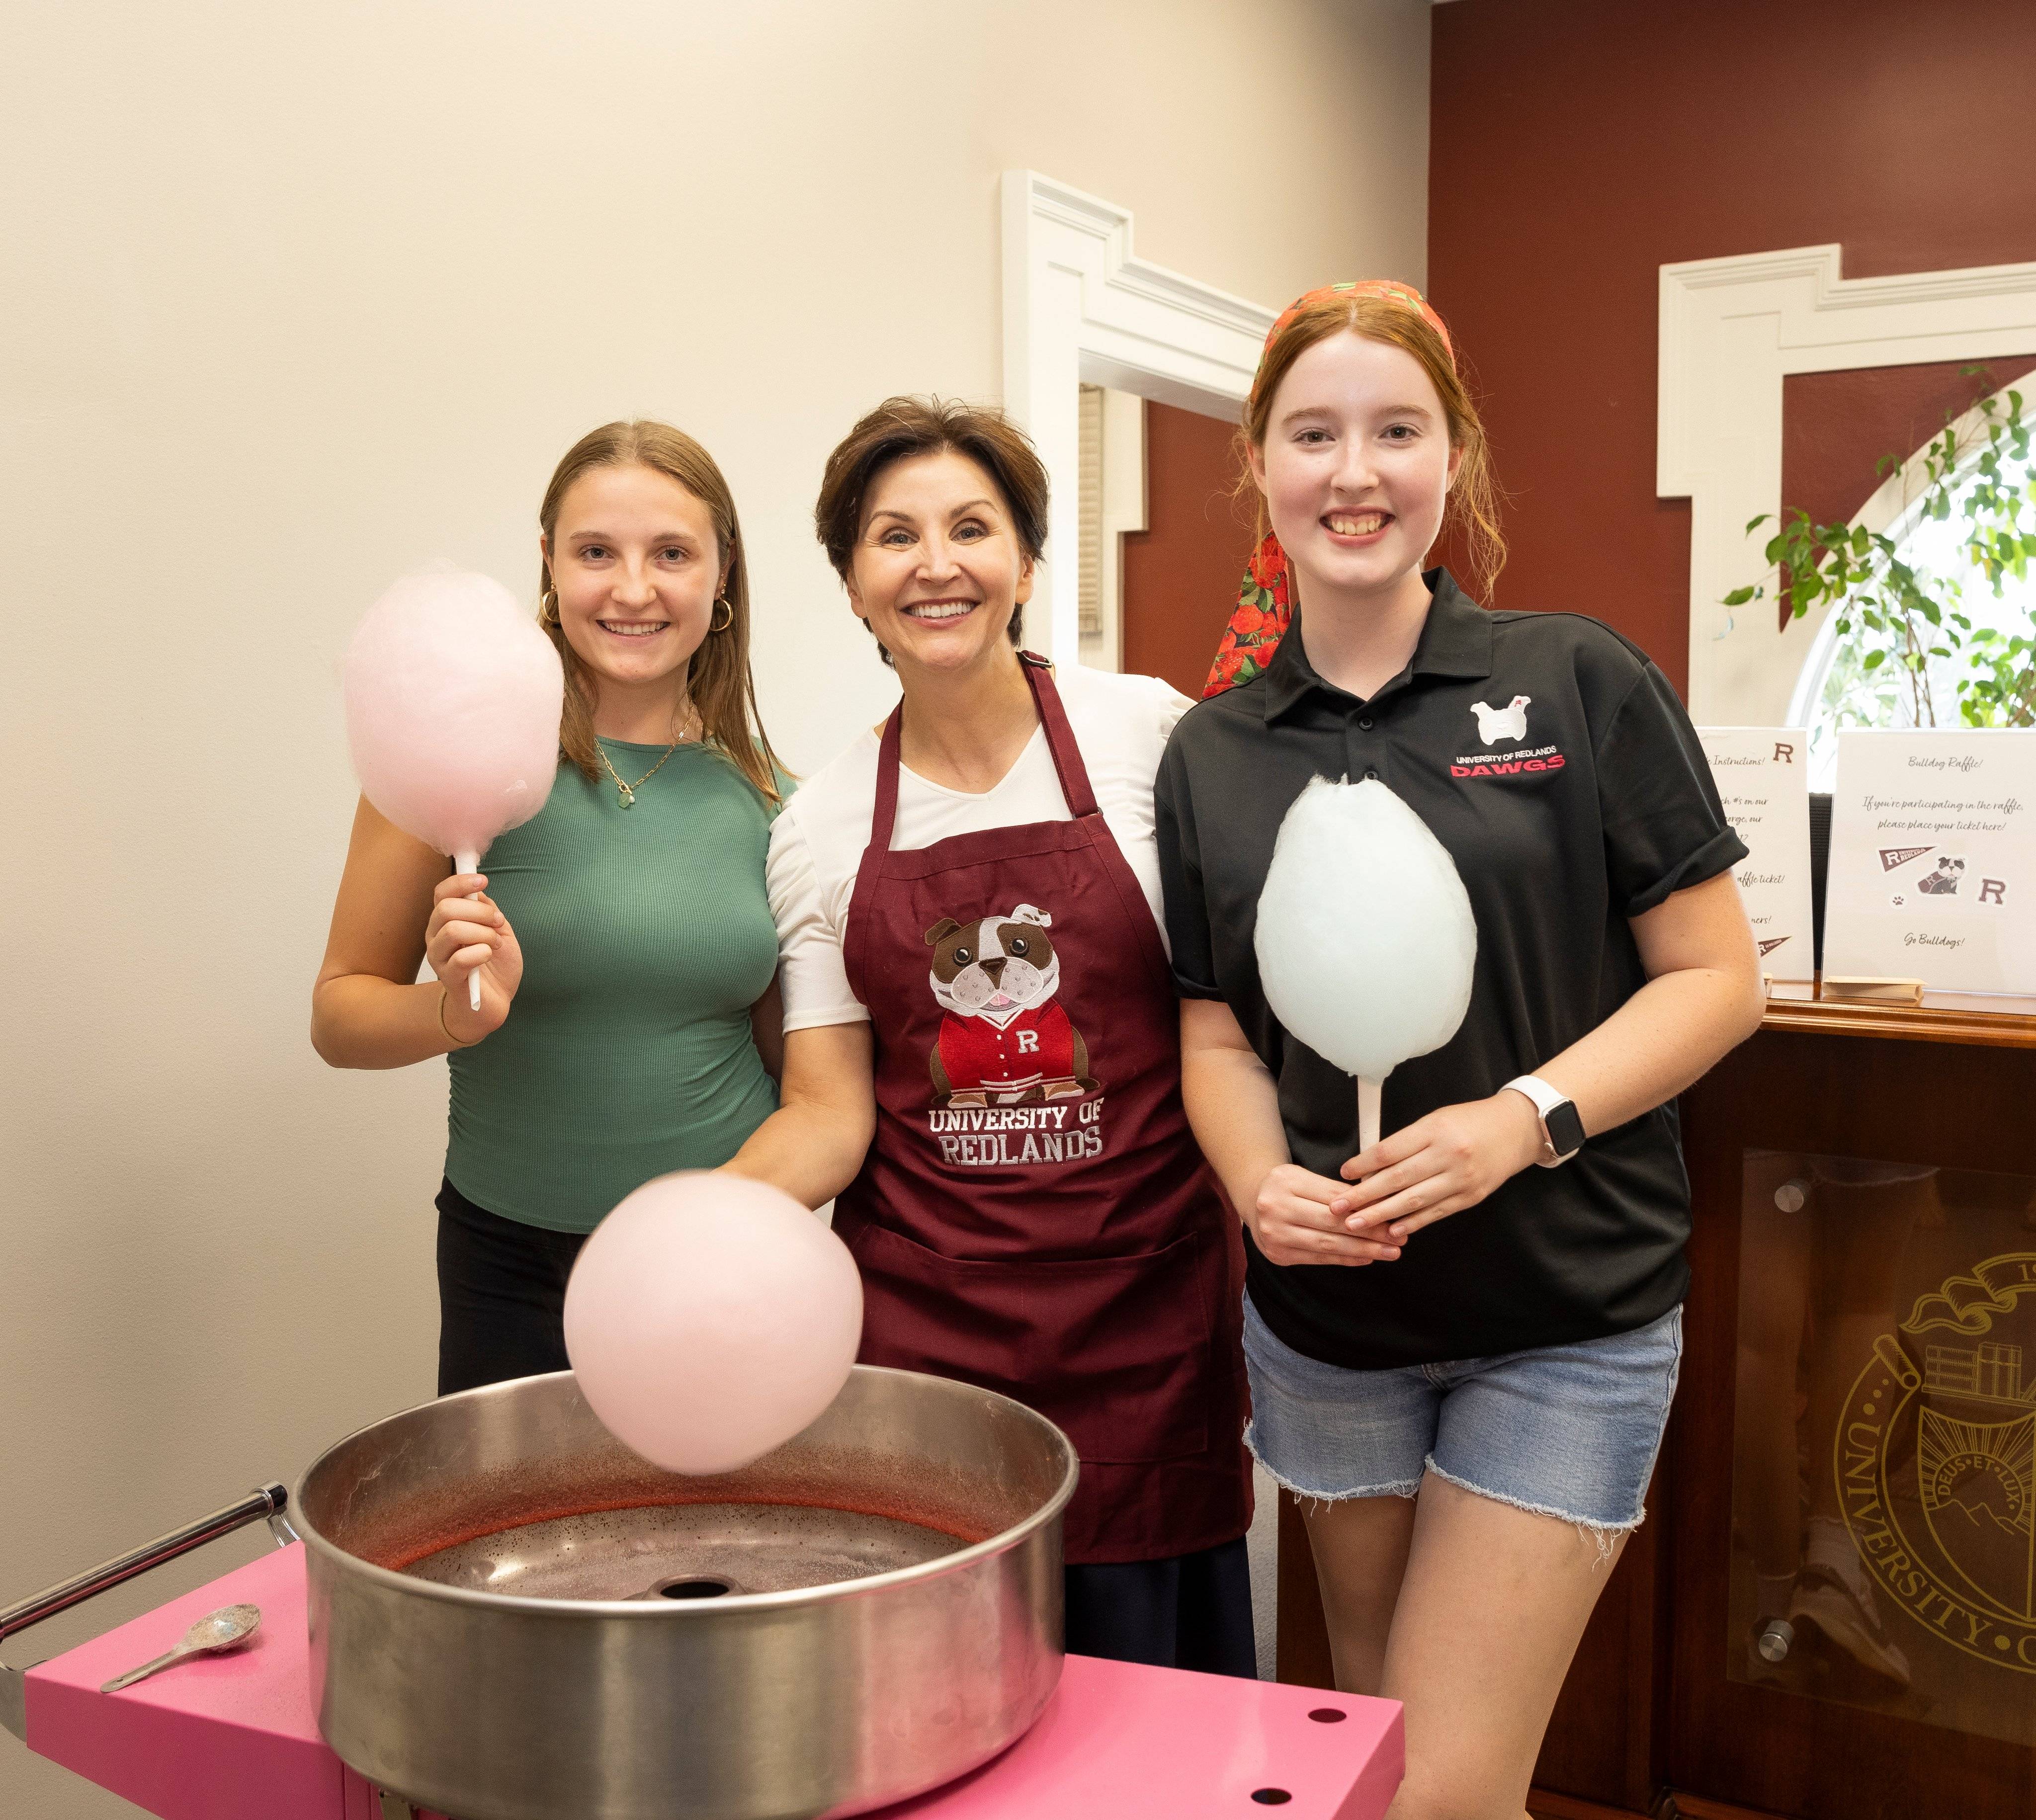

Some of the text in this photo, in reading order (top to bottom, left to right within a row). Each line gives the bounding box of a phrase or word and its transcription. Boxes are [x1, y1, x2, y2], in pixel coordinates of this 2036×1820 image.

[1456, 755, 1502, 764] UNIVERSITY
[1515, 745, 1557, 758] REDLANDS
[1713, 754, 1765, 765] Instructions!
[1773, 743, 1793, 763] R
[1450, 755, 1565, 777] DAWGS
[1908, 756, 1983, 772] Bulldog Raffle!
[1862, 796, 1873, 811] If
[1874, 797, 1900, 810] you're
[1901, 799, 1963, 812] participating
[1976, 800, 1990, 810] the
[1877, 819, 2007, 832] please place your ticket here!
[1885, 851, 1901, 865] R
[1737, 871, 1785, 887] affle ticket!
[1979, 879, 2006, 905] R
[1751, 915, 1772, 924] ners!
[1904, 932, 1965, 949] Go Bulldogs!
[1016, 1029, 1040, 1054] R
[929, 1097, 1104, 1132] UNIVERSITY OF
[938, 1126, 1105, 1166] REDLANDS
[1938, 1455, 2021, 1503] DEUS ET LUX
[1845, 1422, 1993, 1648] UNIVERSITY
